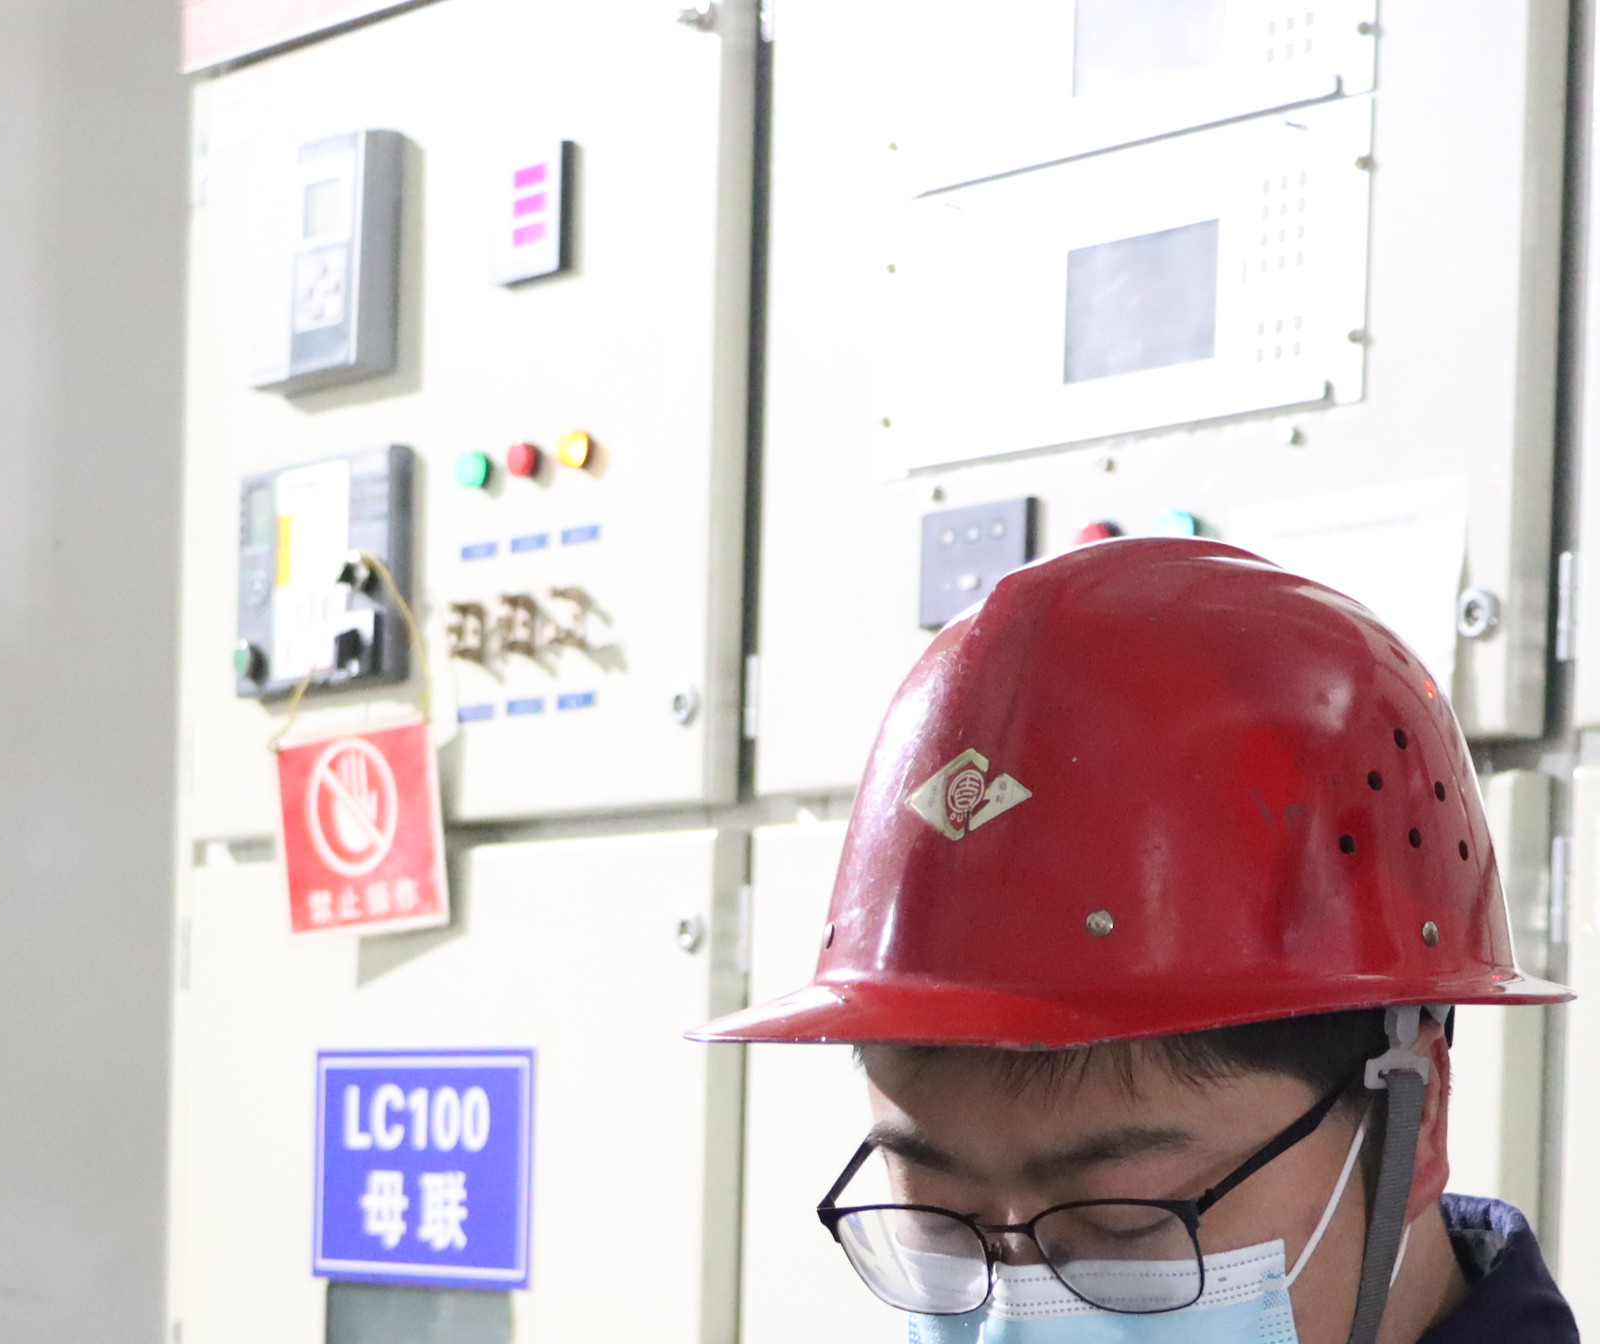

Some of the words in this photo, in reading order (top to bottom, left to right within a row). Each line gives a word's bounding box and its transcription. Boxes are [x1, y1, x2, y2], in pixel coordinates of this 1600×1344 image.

[307, 877, 419, 925] 禁止操作
[343, 1083, 491, 1152] LC100
[359, 1169, 468, 1250] 母联
